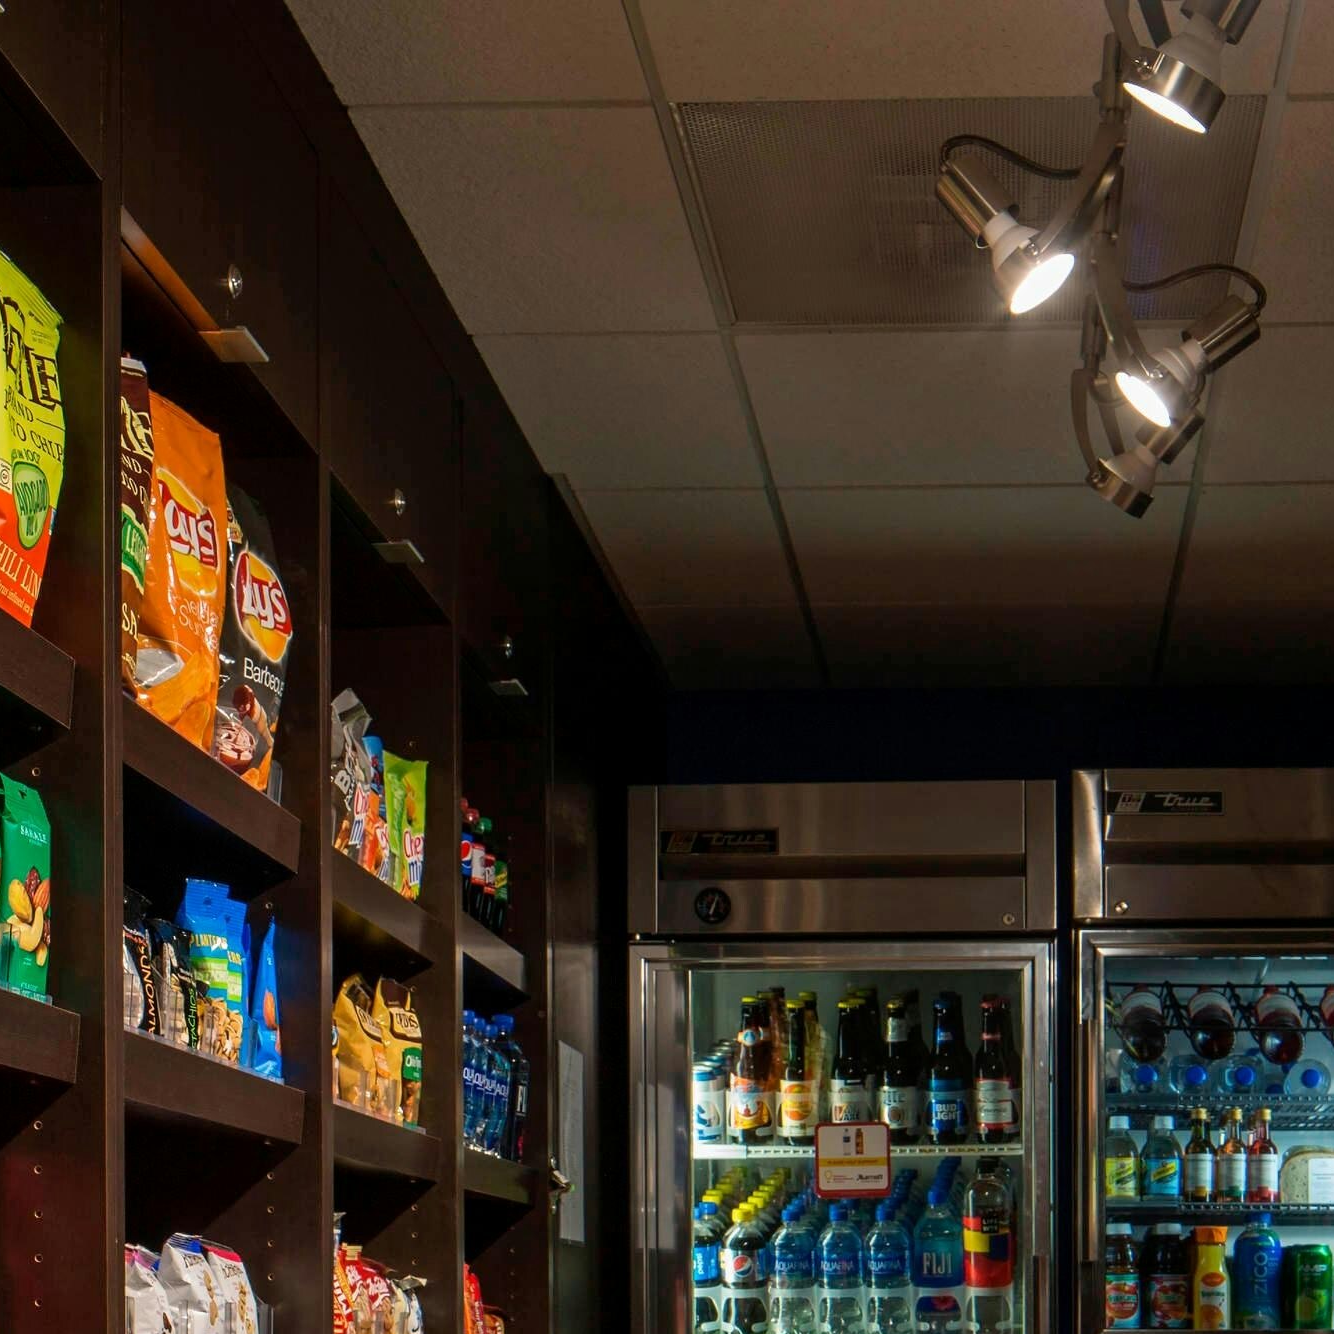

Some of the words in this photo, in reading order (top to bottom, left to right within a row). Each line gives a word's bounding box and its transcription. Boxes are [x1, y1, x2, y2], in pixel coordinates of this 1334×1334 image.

[932, 1111, 960, 1121] LIGHT
[935, 1103, 957, 1112] BUD
[922, 1251, 953, 1276] FIJI
[1253, 1253, 1268, 1297] ZICO
